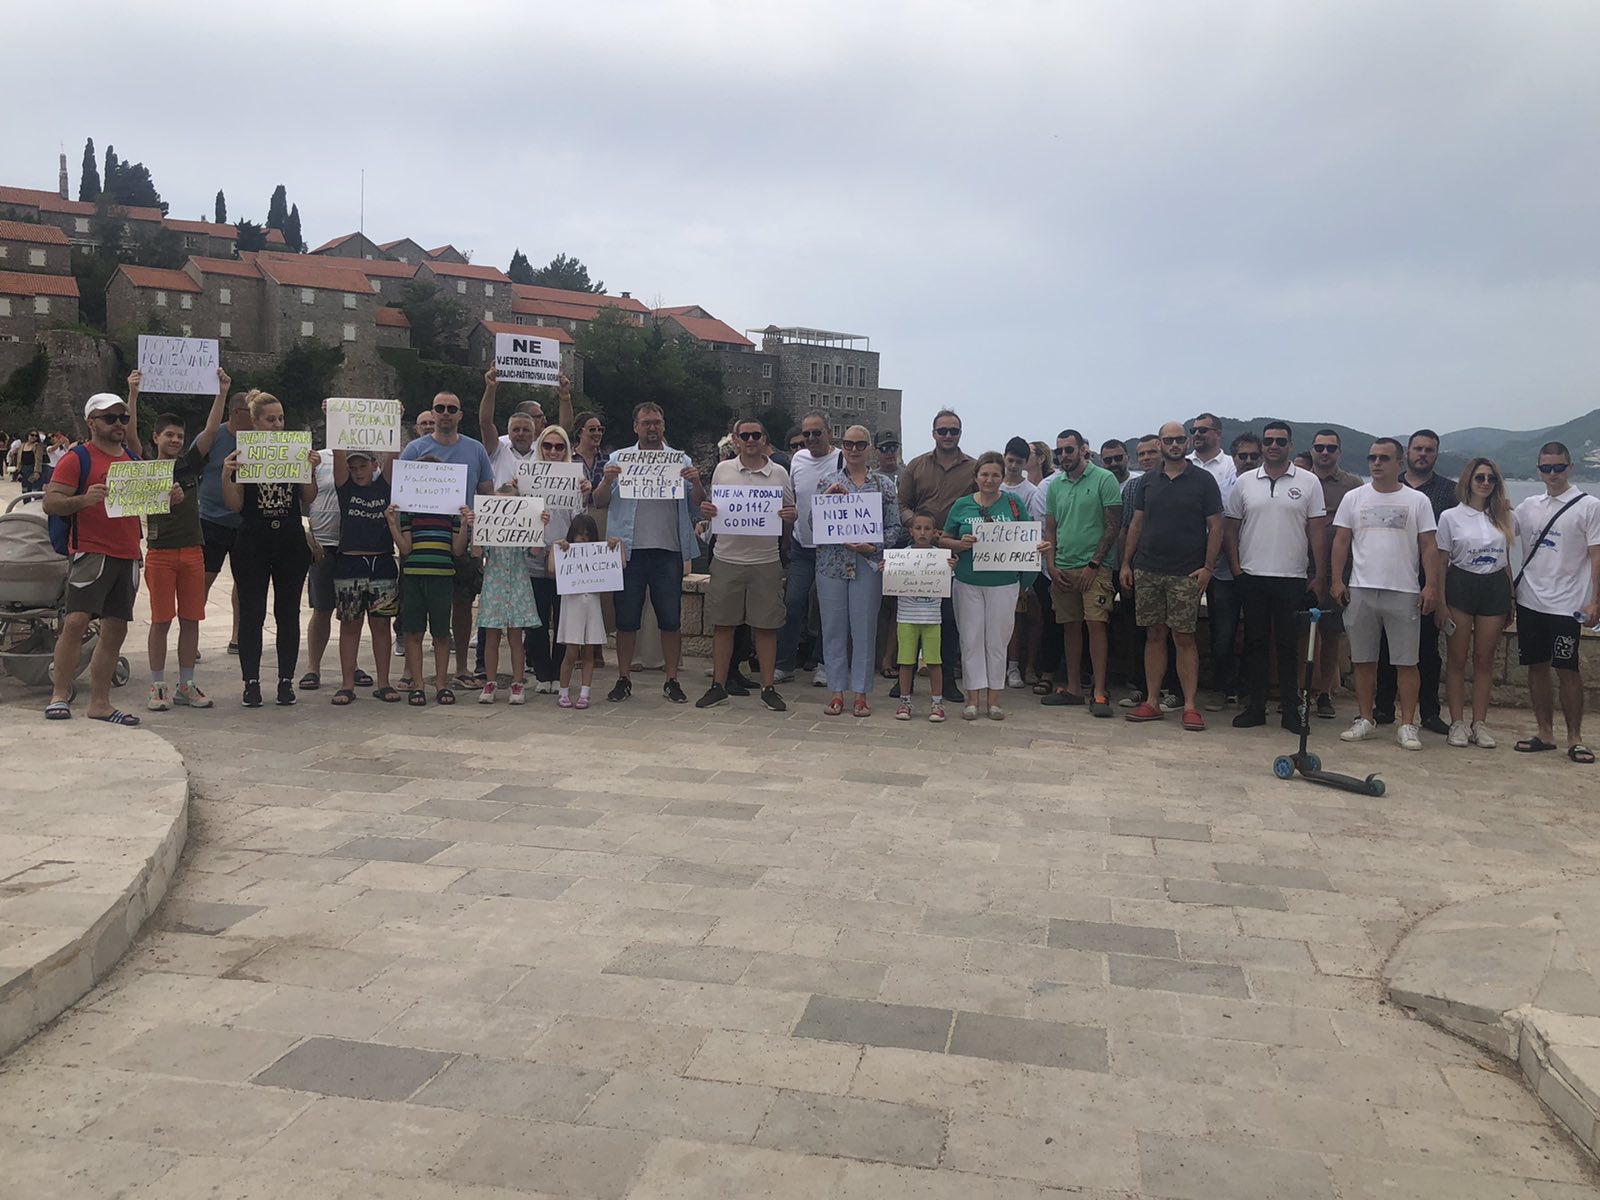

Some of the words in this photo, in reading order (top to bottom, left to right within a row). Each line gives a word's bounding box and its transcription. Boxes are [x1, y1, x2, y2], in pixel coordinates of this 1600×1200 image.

[196, 340, 208, 353] JE
[513, 339, 541, 354] NE
[496, 356, 558, 370] VJETROELEKTRANI
[270, 432, 310, 444] STEFAN
[248, 446, 288, 461] NIJE
[239, 463, 263, 478] BIT
[519, 463, 552, 476] SVETI
[627, 464, 670, 476] PLEASE
[532, 476, 580, 490] STEFAN
[713, 489, 730, 498] NIJE
[733, 489, 744, 498] NA
[748, 489, 783, 499] PRODAJU
[814, 494, 864, 506] ISTORIJA
[480, 499, 529, 515] STOP
[729, 503, 743, 512] OD
[823, 509, 849, 520] NIJE
[854, 508, 872, 519] NA
[477, 515, 532, 528] PRODAJI
[724, 518, 766, 528] GODINE
[828, 522, 882, 537] PRODAJU
[991, 524, 1038, 543] Stefan
[973, 551, 991, 563] HAS
[994, 552, 1006, 563] NO
